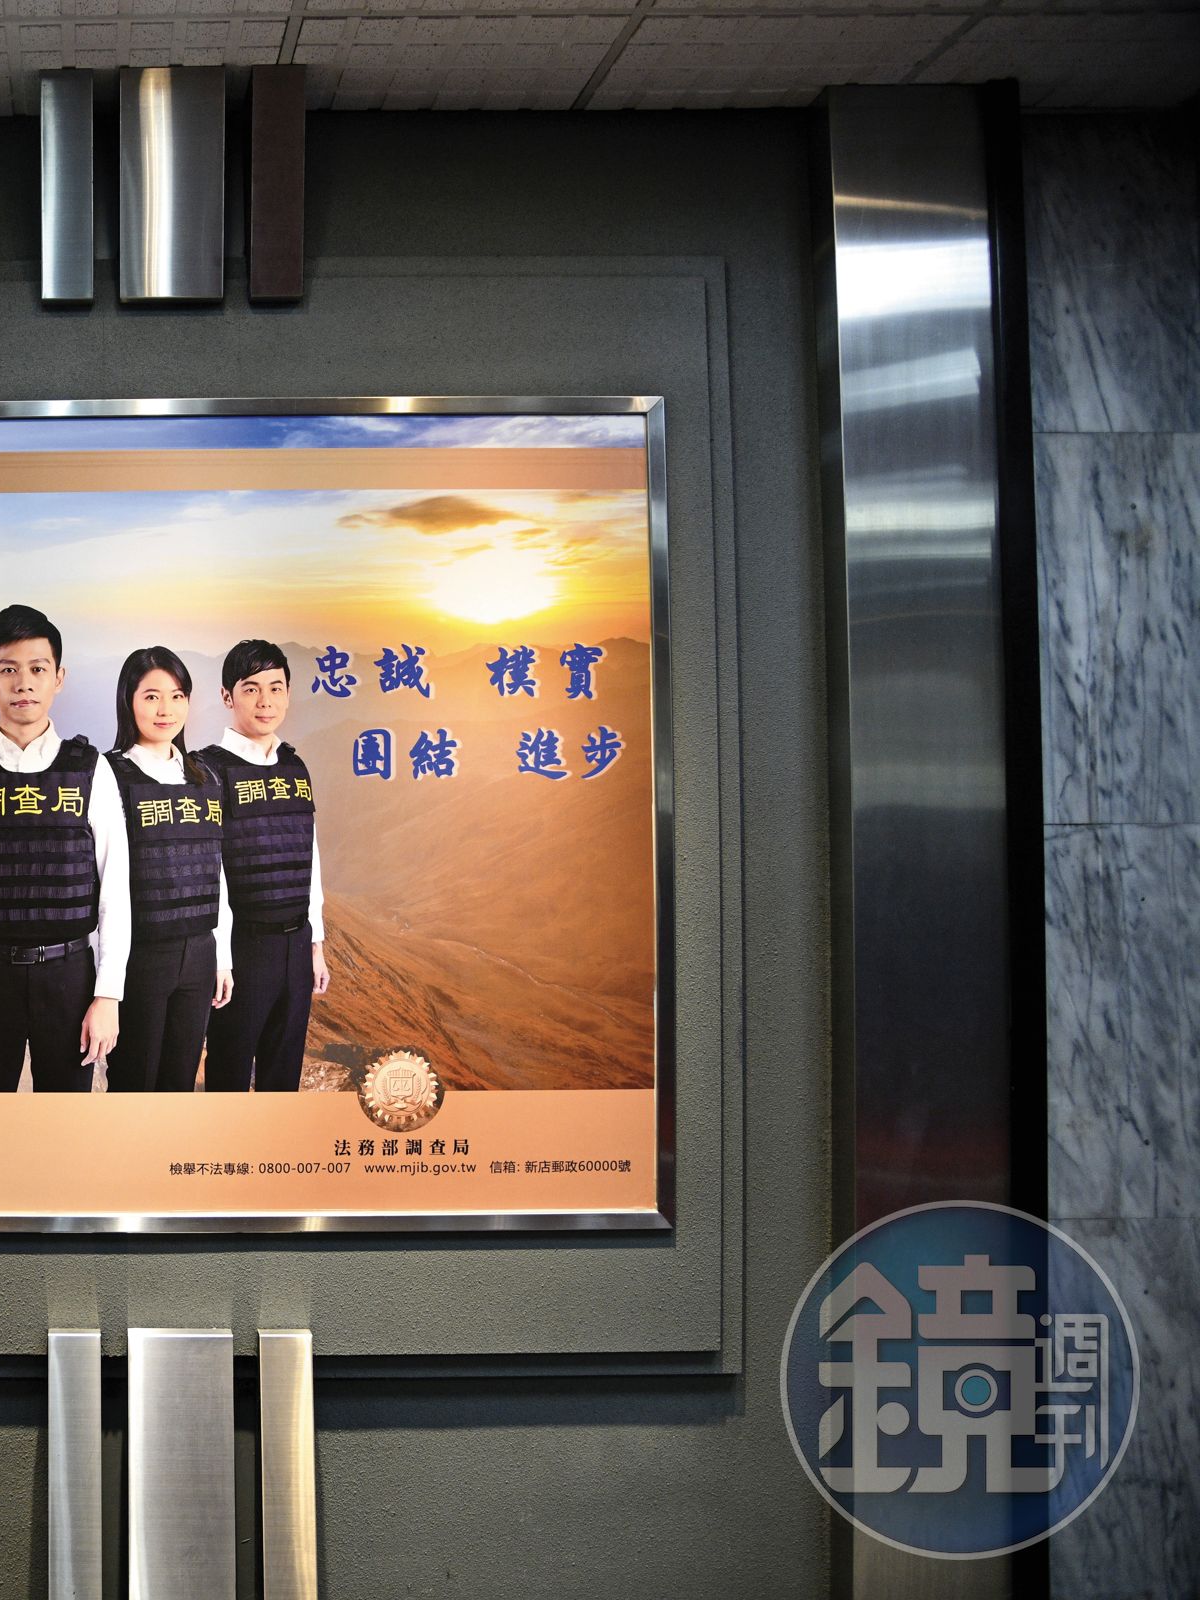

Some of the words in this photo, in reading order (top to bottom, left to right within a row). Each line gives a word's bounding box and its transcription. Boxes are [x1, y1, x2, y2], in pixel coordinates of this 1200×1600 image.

[311, 643, 433, 699] 忠誠
[485, 643, 604, 700] 樸實
[352, 728, 459, 780] 團結
[515, 726, 623, 781] 進步
[234, 776, 312, 805] 調查局
[137, 796, 223, 827] 調查局
[334, 1138, 470, 1156] 法務部調查局
[258, 1162, 351, 1174] 0800-007-007
[364, 1161, 477, 1176] www.mjib.gov.tw
[524, 1159, 632, 1174] 新店郵政60000號
